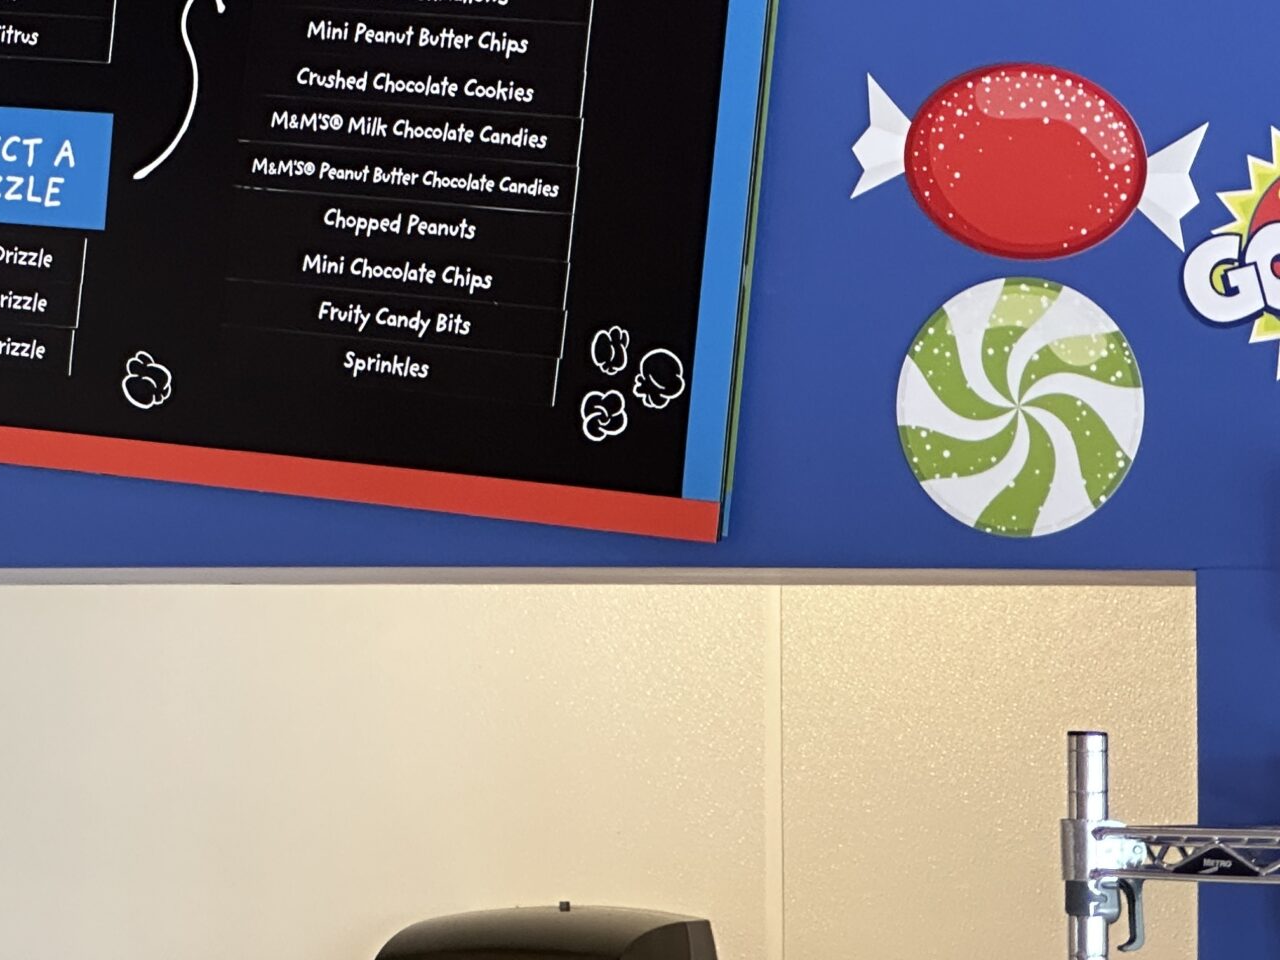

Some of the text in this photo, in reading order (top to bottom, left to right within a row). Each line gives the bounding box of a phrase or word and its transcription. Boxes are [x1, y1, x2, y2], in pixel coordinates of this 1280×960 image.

[307, 20, 528, 58] Mini Peanut Butter Chips
[296, 67, 534, 103] Crushed Chocolate Cookies
[348, 116, 388, 138] Milk
[392, 119, 474, 143] Chocolate
[479, 125, 548, 149] Candies
[54, 139, 75, 168] A
[319, 162, 369, 183] Peanut
[373, 167, 419, 186] Butter
[422, 170, 495, 192] Chocolate
[499, 177, 559, 198] Candies
[323, 208, 476, 240] Chopped Peanuts
[302, 254, 493, 294] Mini Chocolate Chips
[318, 301, 471, 338] Fruity Candy Bits
[343, 351, 429, 379] Sprinkles
